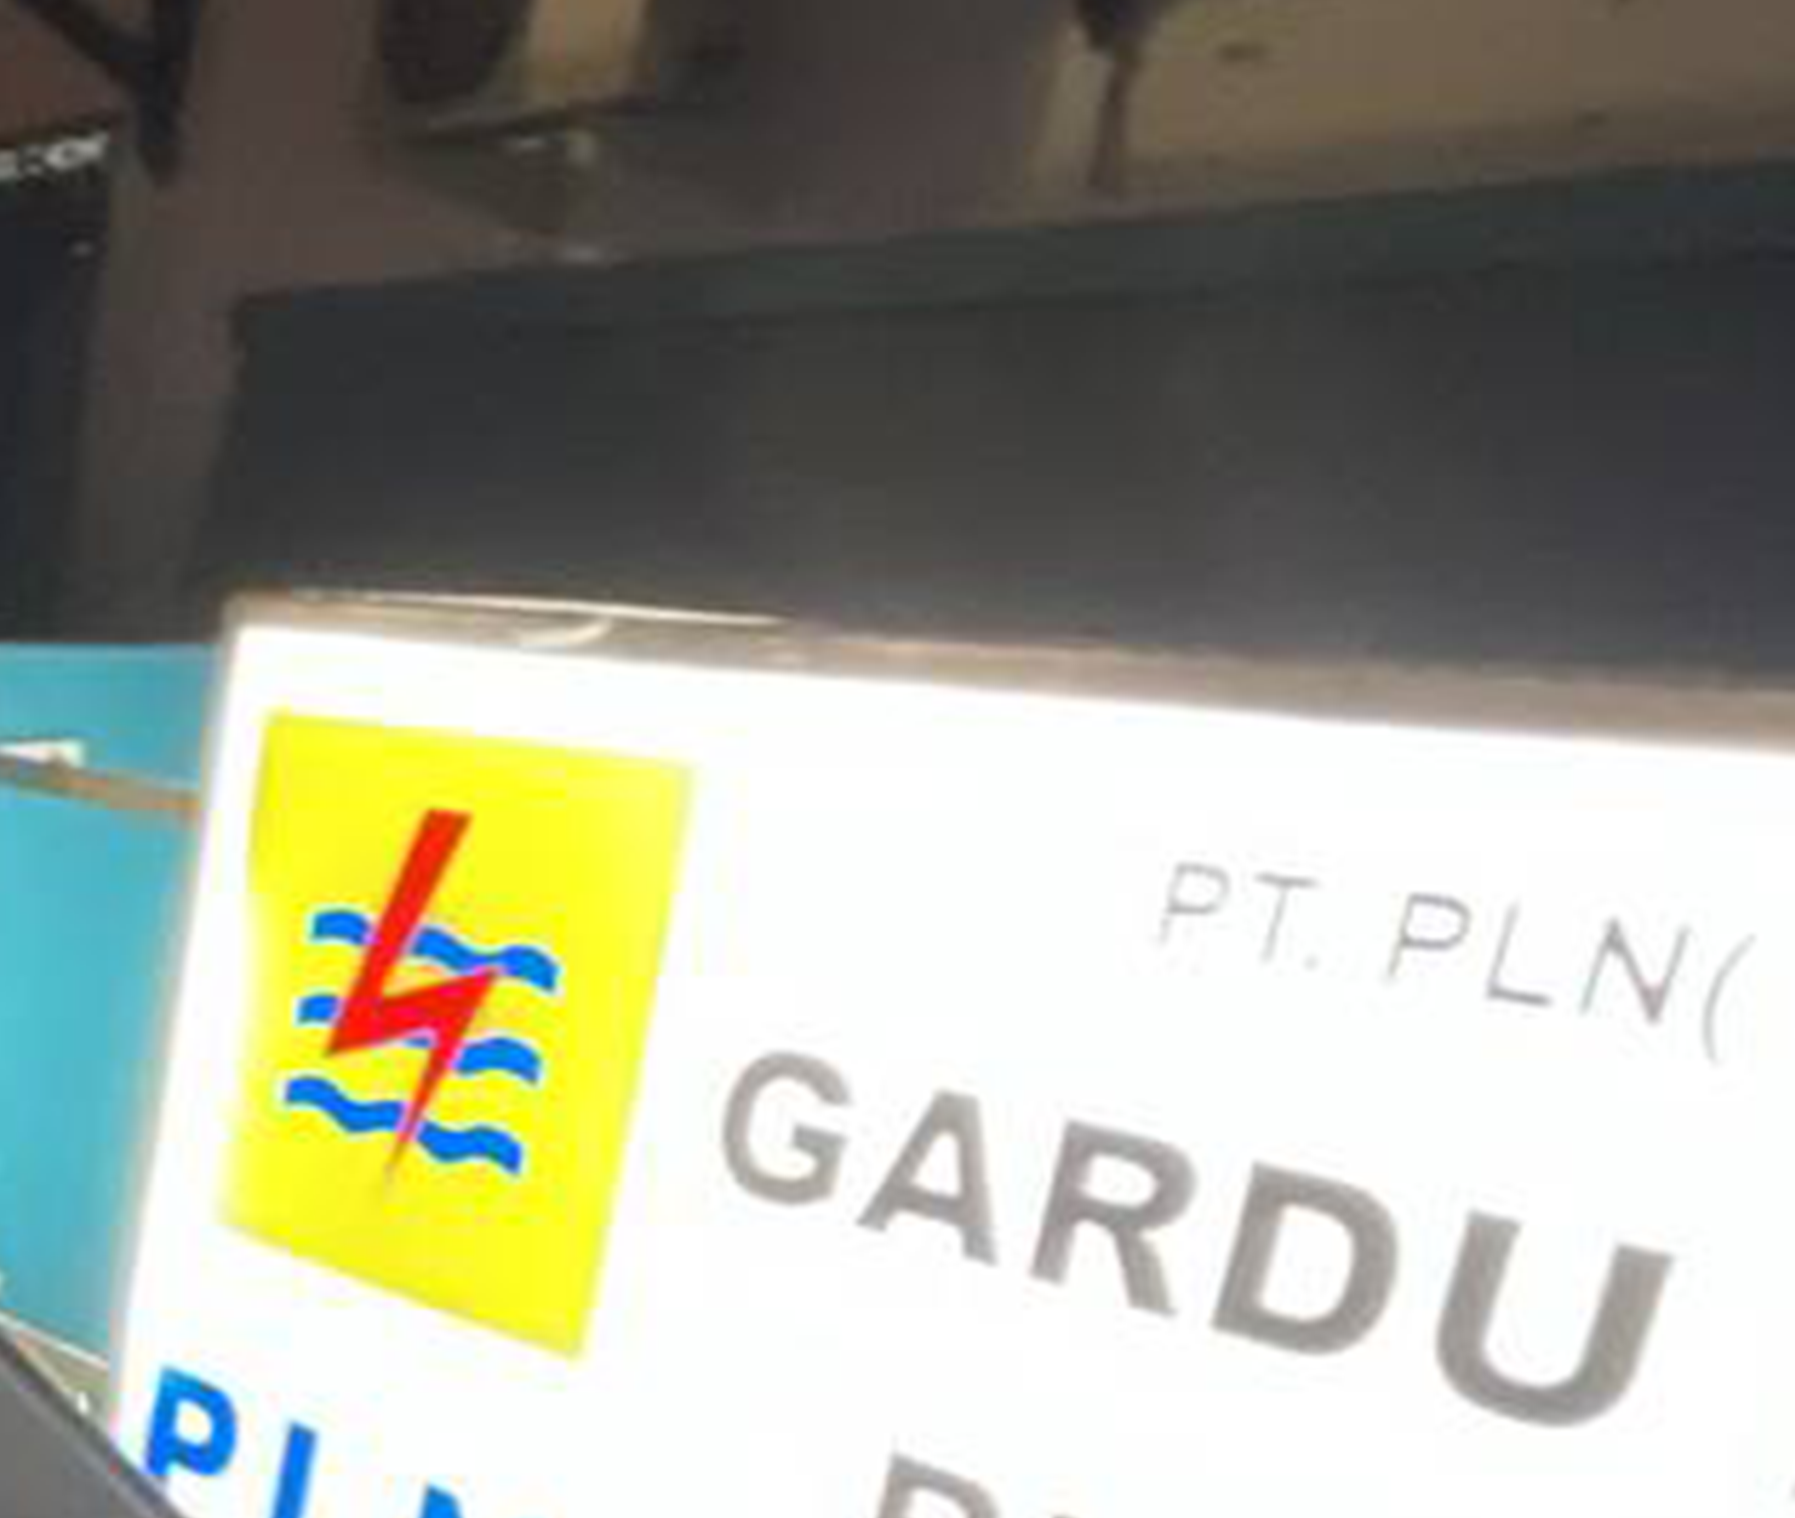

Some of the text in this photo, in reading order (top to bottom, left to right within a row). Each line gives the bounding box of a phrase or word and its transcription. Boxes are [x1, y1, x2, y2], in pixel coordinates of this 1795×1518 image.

[1157, 859, 1758, 1064] PT. PLN(
[718, 1049, 1677, 1430] GARDU
